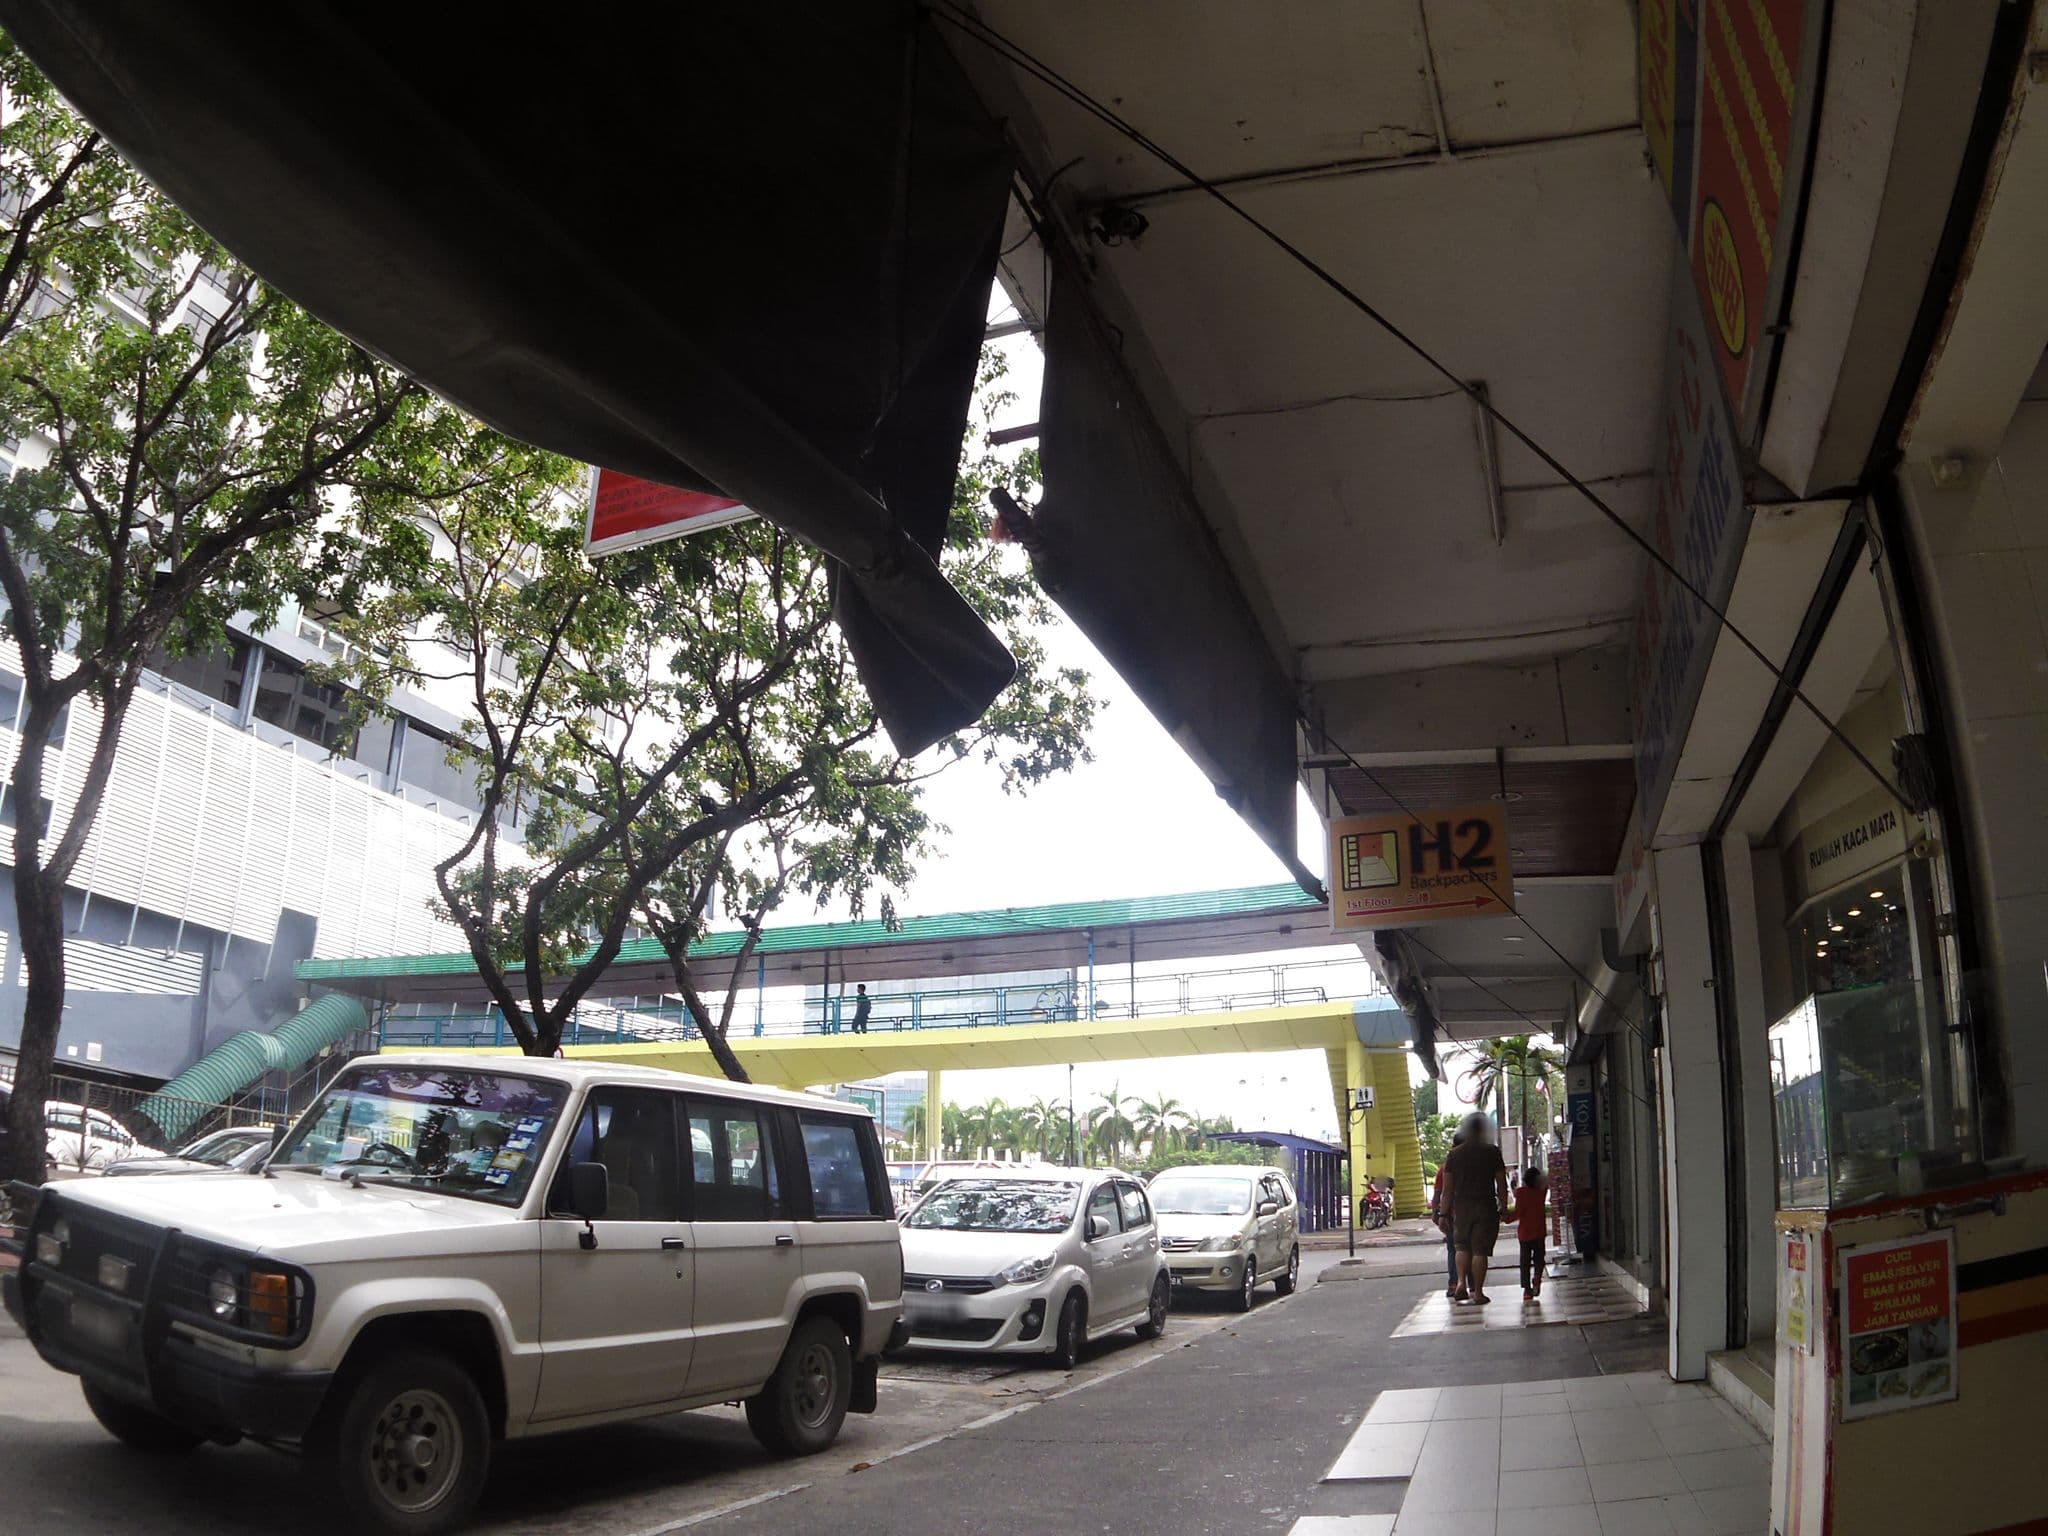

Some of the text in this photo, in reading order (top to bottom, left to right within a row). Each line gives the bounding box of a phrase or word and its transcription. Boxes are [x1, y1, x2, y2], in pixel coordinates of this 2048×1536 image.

[1409, 819, 1494, 874] H2
[1809, 811, 1897, 869] RUMAH KACA MATA
[1410, 872, 1498, 889] Backpackers
[1347, 898, 1393, 909] 1st Floor
[1885, 1250, 1912, 1265] CUCI
[1863, 1276, 1936, 1299] EMAS KOREA
[1873, 1293, 1921, 1312] ZHULIAN
[1863, 1304, 1938, 1329] JAM TANGAN
